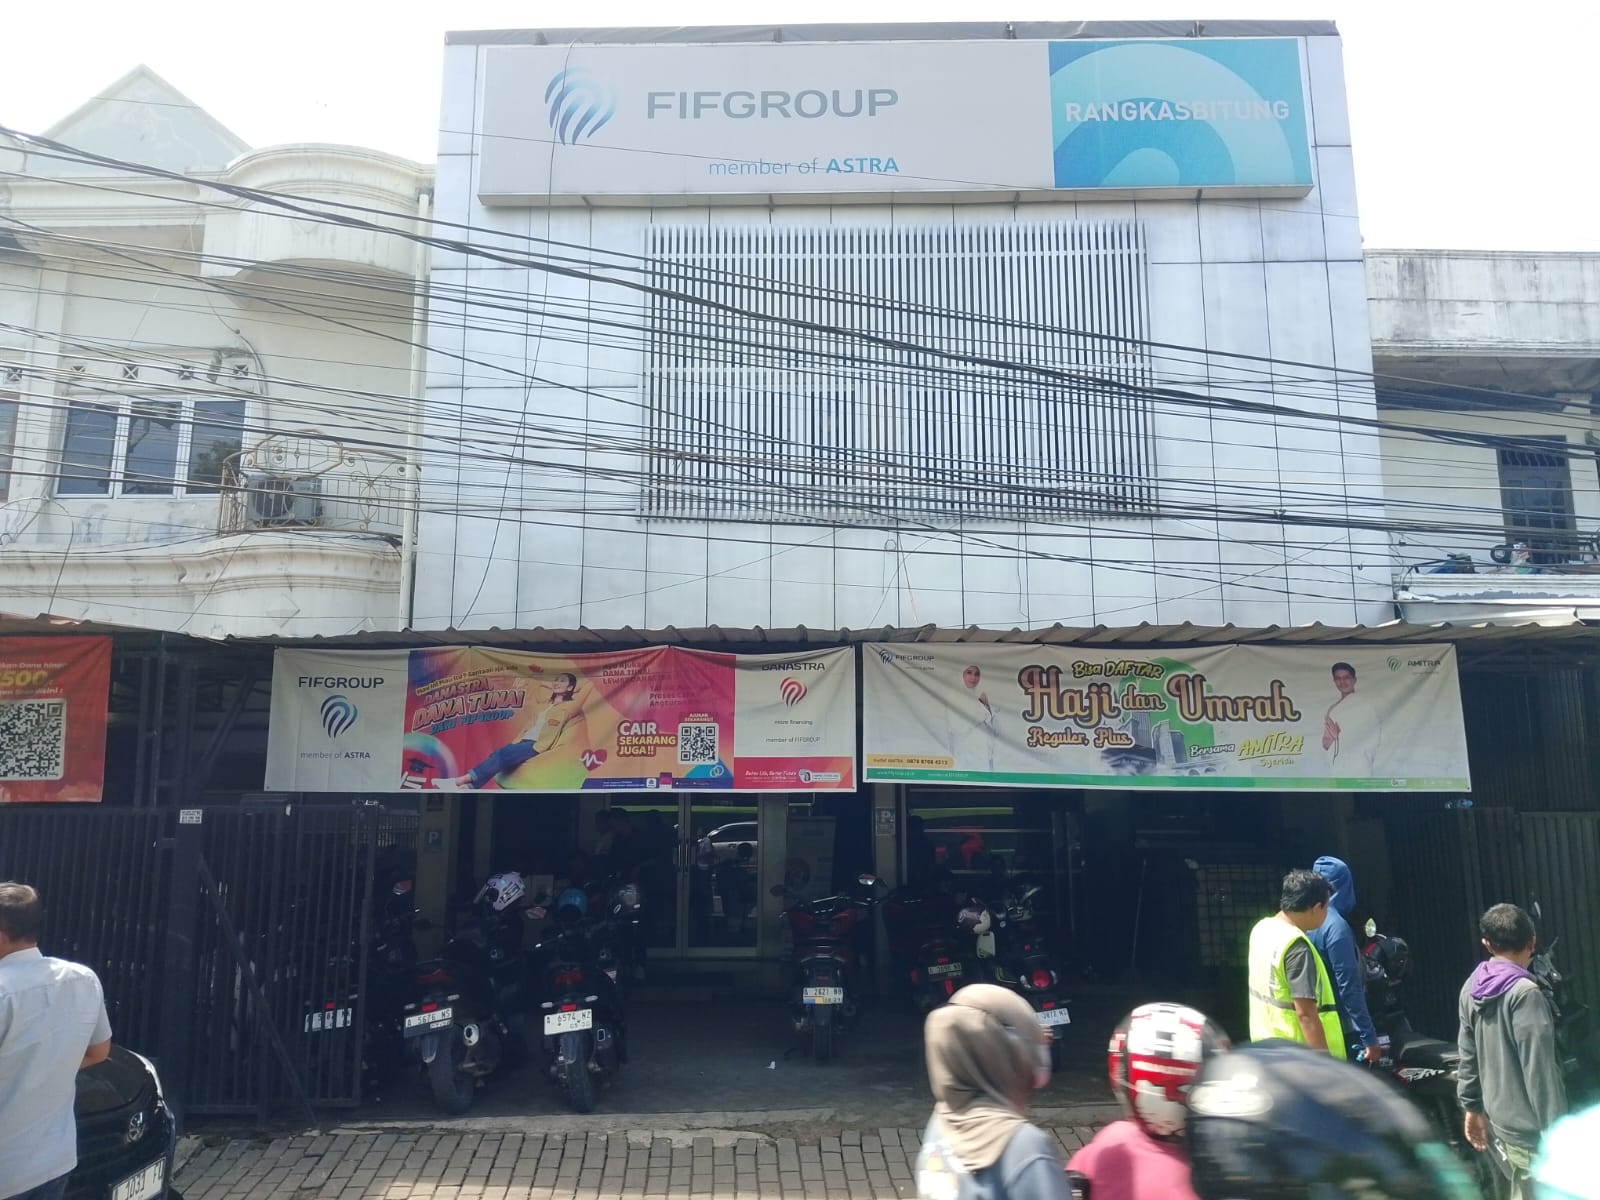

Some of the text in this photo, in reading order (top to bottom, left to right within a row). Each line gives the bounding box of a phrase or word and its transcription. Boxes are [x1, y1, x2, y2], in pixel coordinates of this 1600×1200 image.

[647, 89, 899, 119] FIFGROUP
[1065, 100, 1289, 122] RANGKASBITUNG
[709, 157, 899, 175] member of ASTRA
[761, 662, 826, 671] DANASTRA
[1072, 659, 1165, 679] Bisa DAFTAR
[298, 676, 385, 688] FIFGROUP
[1018, 664, 1302, 729] Haji dan Umrah
[412, 689, 526, 732] DANA TUNAI
[619, 721, 657, 736] CAIR
[619, 736, 676, 745] SEKARANG
[1028, 726, 1089, 748] Reguler,
[1190, 731, 1305, 758] Bersama AMITRA
[334, 751, 342, 759] of
[1259, 757, 1295, 769] Syariah
[814, 988, 829, 996] 2621
[407, 1018, 412, 1026] A
[417, 1013, 437, 1025] 5676
